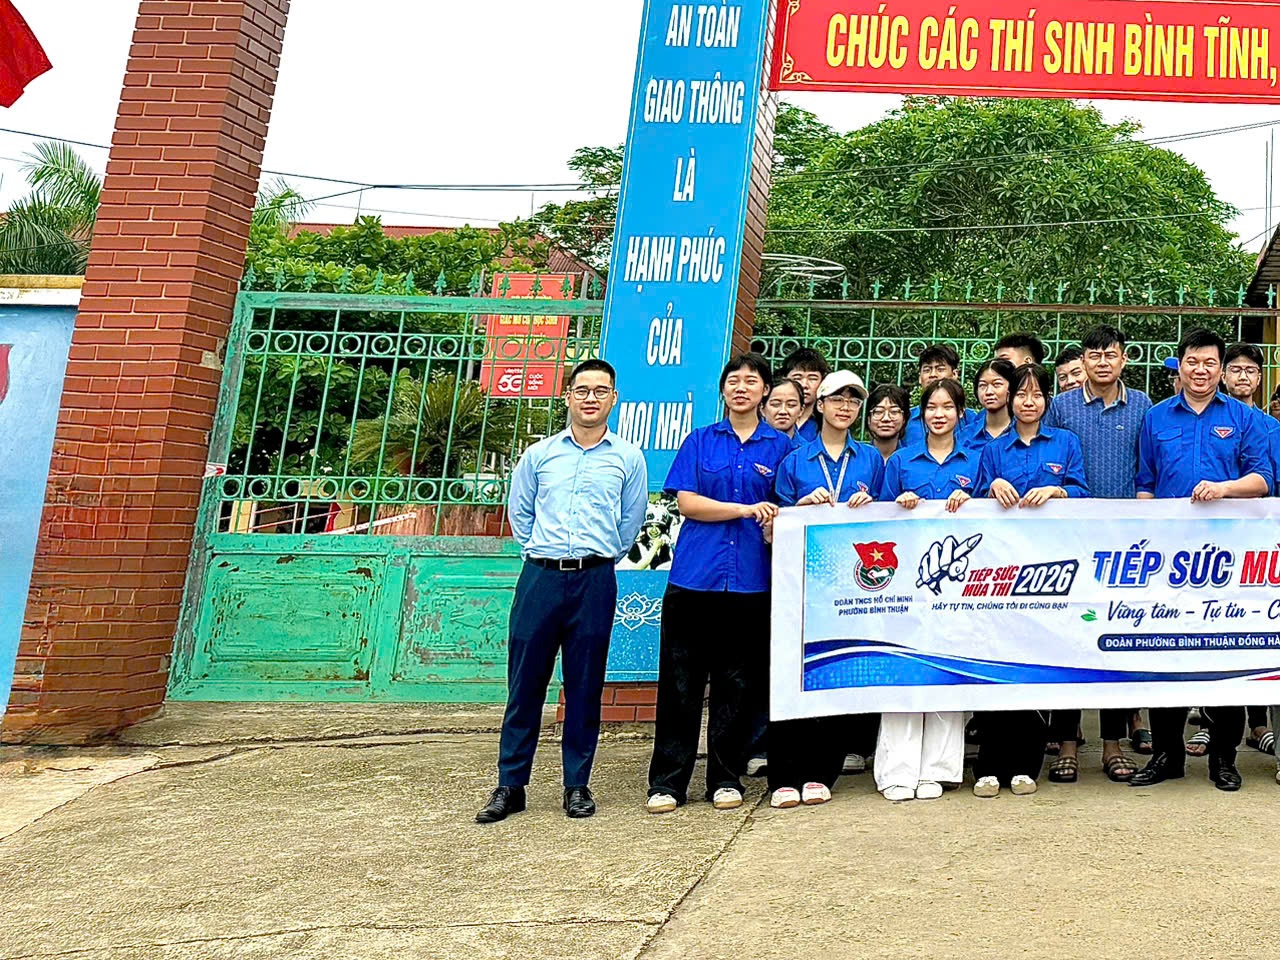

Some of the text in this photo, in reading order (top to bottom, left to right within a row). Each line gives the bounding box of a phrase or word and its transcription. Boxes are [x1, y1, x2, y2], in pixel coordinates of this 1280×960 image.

[665, 4, 693, 47] AN
[825, 3, 910, 69] CHÚC
[918, 6, 979, 71] CÁC
[989, 8, 1037, 73] THÍ
[1042, 20, 1115, 76] SINH
[1123, 12, 1195, 78] BÌNH
[1203, 15, 1277, 87] TĨNH,
[643, 71, 745, 125] GIAO THÔNG
[672, 147, 696, 202] LÀ
[623, 227, 726, 293] HẠNH PHÚC
[646, 301, 684, 366] CỦA
[968, 563, 1019, 583] TIẾP SỨC
[1014, 562, 1075, 594] 2026
[1092, 538, 1164, 586] TIẾP
[1168, 542, 1234, 587] SỨC
[961, 581, 1013, 597] MÙA THI
[1106, 600, 1147, 628] Vững
[1150, 599, 1181, 619] tâm
[1201, 599, 1223, 623] Tự
[1225, 601, 1247, 619] tin
[1105, 636, 1133, 648] ĐOÀN
[1135, 635, 1176, 647] PHƯỜNG
[1178, 635, 1201, 647] BÌNH
[1203, 635, 1236, 649] THUẬN
